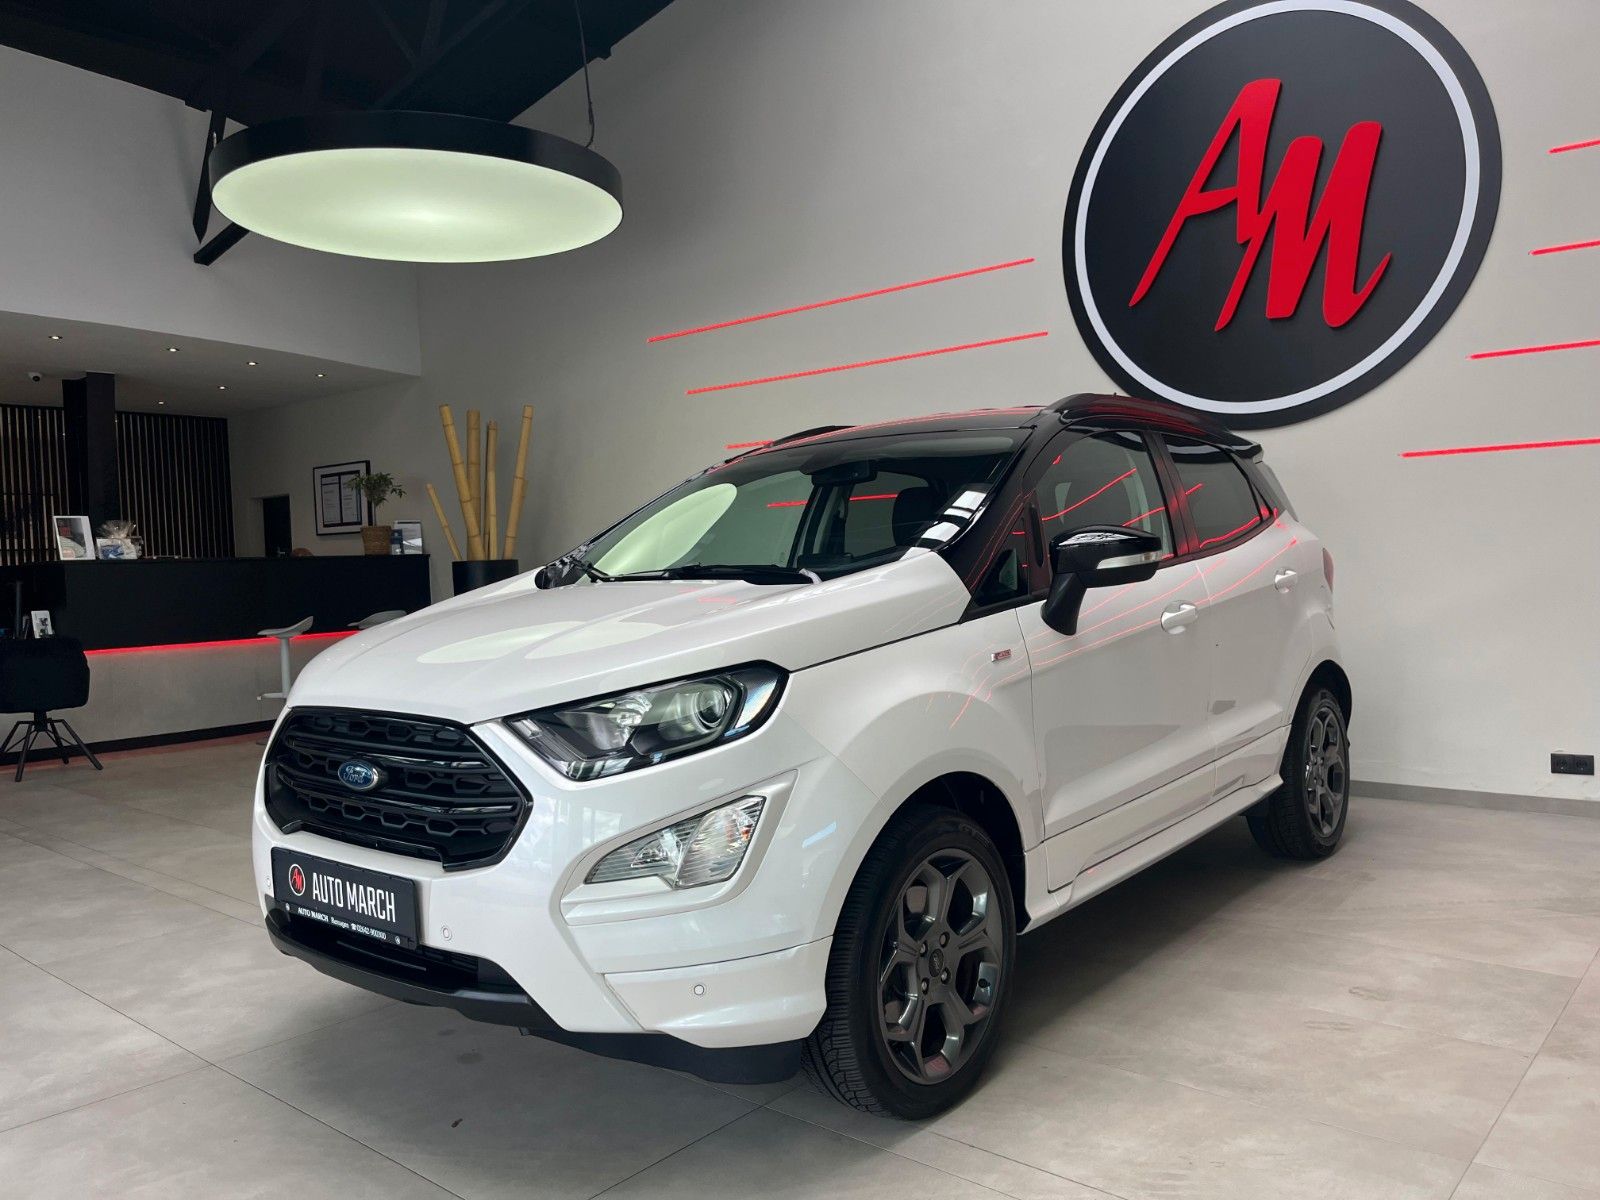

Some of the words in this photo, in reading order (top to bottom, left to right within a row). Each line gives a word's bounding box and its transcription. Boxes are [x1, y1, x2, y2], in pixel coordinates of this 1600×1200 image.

[1128, 78, 1393, 332] AM
[297, 906, 310, 917] AUTO
[312, 872, 344, 908] AUTO
[346, 881, 396, 923] MARCH
